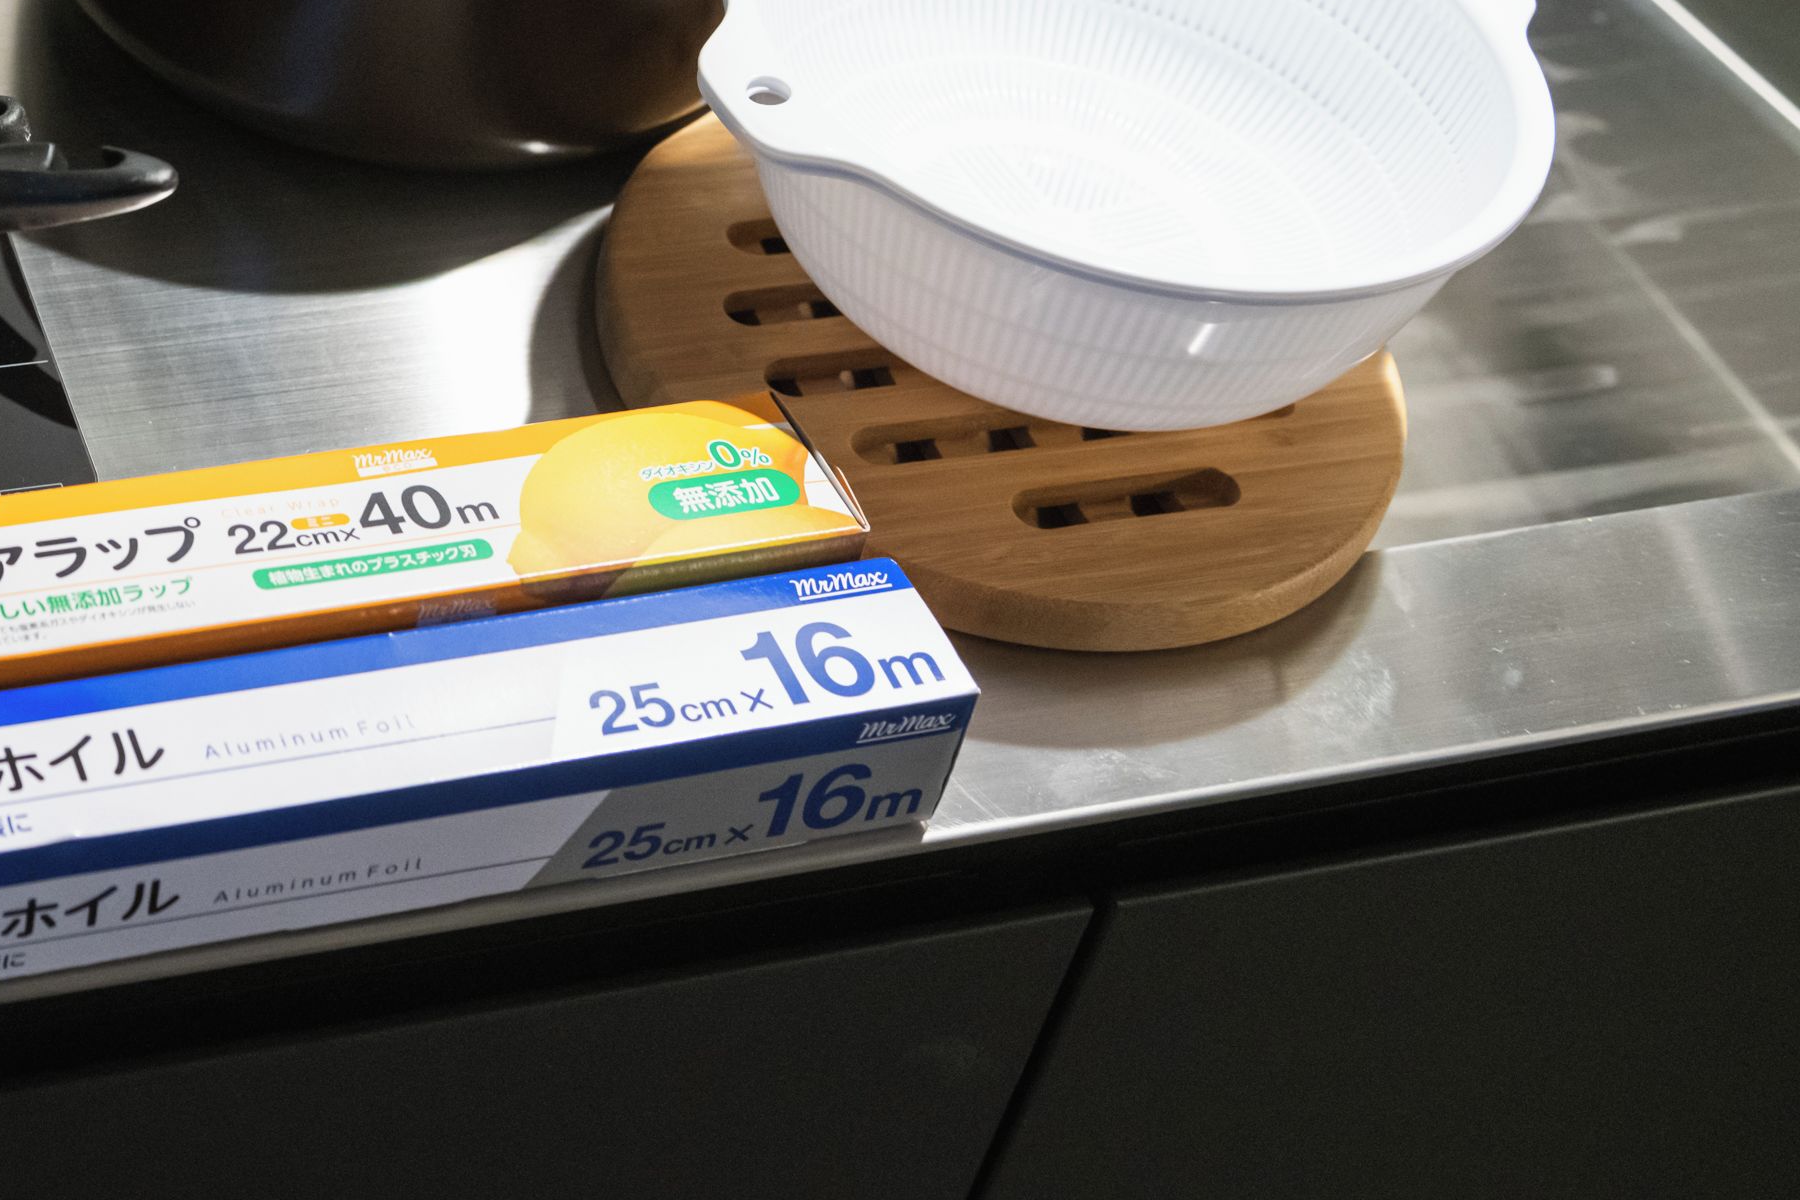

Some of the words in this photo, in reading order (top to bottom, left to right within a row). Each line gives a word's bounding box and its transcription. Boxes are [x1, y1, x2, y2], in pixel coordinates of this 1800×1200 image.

[351, 448, 433, 468] MrMax
[287, 496, 339, 512] Wrap
[673, 477, 780, 514] 無添加
[268, 544, 477, 586] 植物生まれのプラスチック刃
[789, 570, 890, 598] MrMax
[204, 725, 350, 761] Aluminum
[356, 714, 417, 737] Foil
[859, 712, 957, 741] MrMax
[213, 870, 357, 905] Aluminum
[367, 857, 423, 878] Foil
